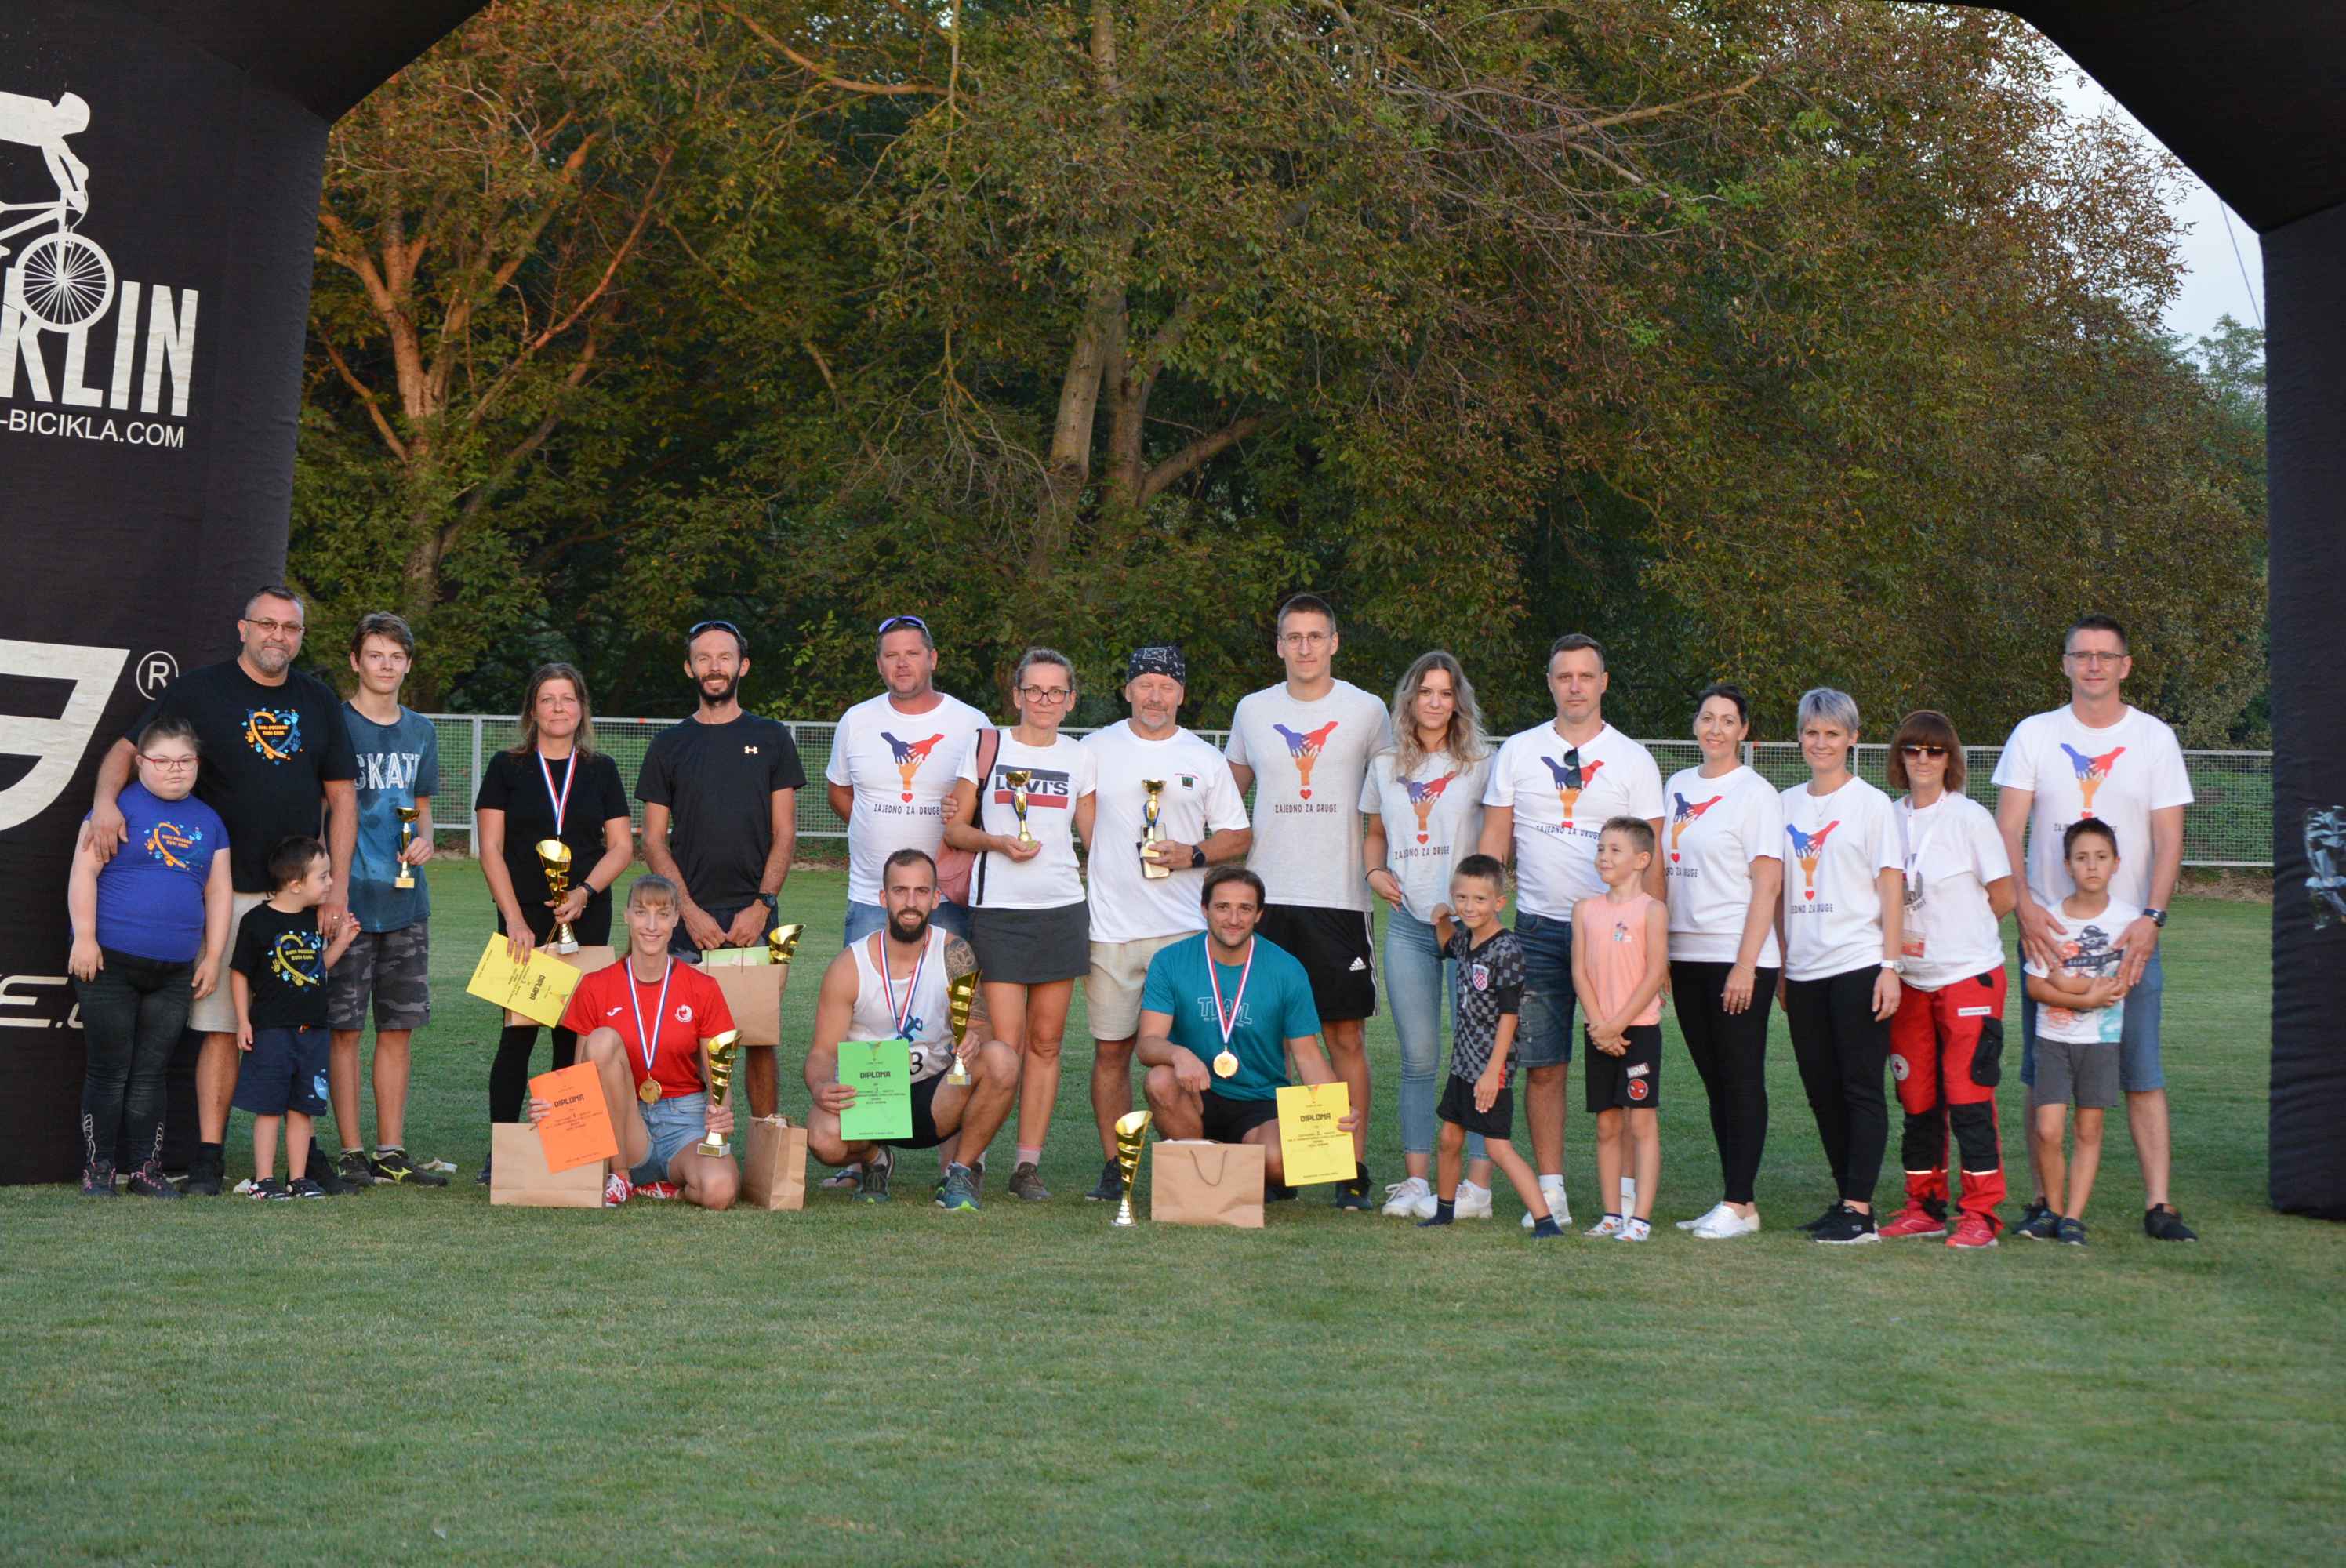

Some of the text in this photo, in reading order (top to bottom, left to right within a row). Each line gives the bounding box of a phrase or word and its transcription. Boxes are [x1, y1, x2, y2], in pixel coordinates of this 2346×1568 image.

[873, 804, 940, 815] ZAJEDNO ZA DRUGE
[1275, 804, 1337, 813] ZAJEDNO ZA DRUGE
[529, 975, 547, 1001] DIPLOMA
[554, 1094, 585, 1108] DIPLOMA
[1300, 1112, 1331, 1122] DIPLOMA
